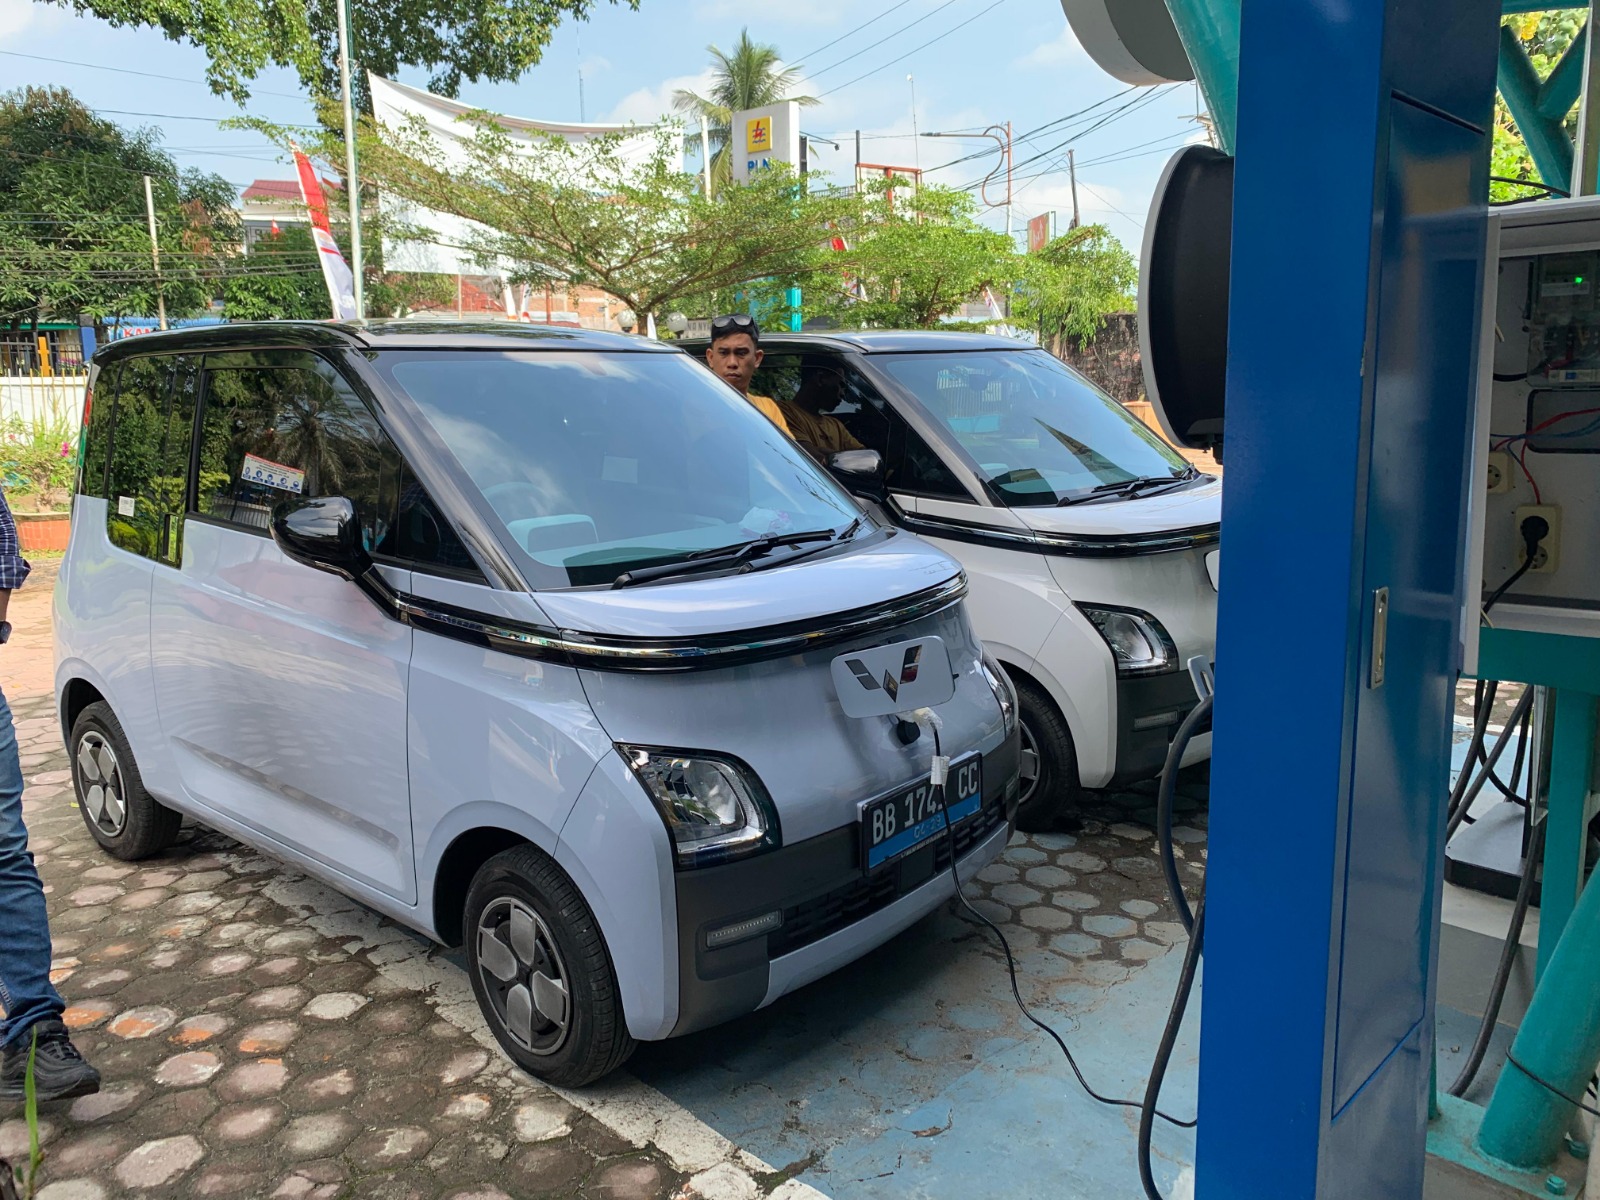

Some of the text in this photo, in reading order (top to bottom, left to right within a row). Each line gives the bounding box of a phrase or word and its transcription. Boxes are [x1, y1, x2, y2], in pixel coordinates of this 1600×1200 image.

[872, 802, 896, 845] BB
[904, 782, 947, 828] 174
[958, 761, 978, 799] CC
